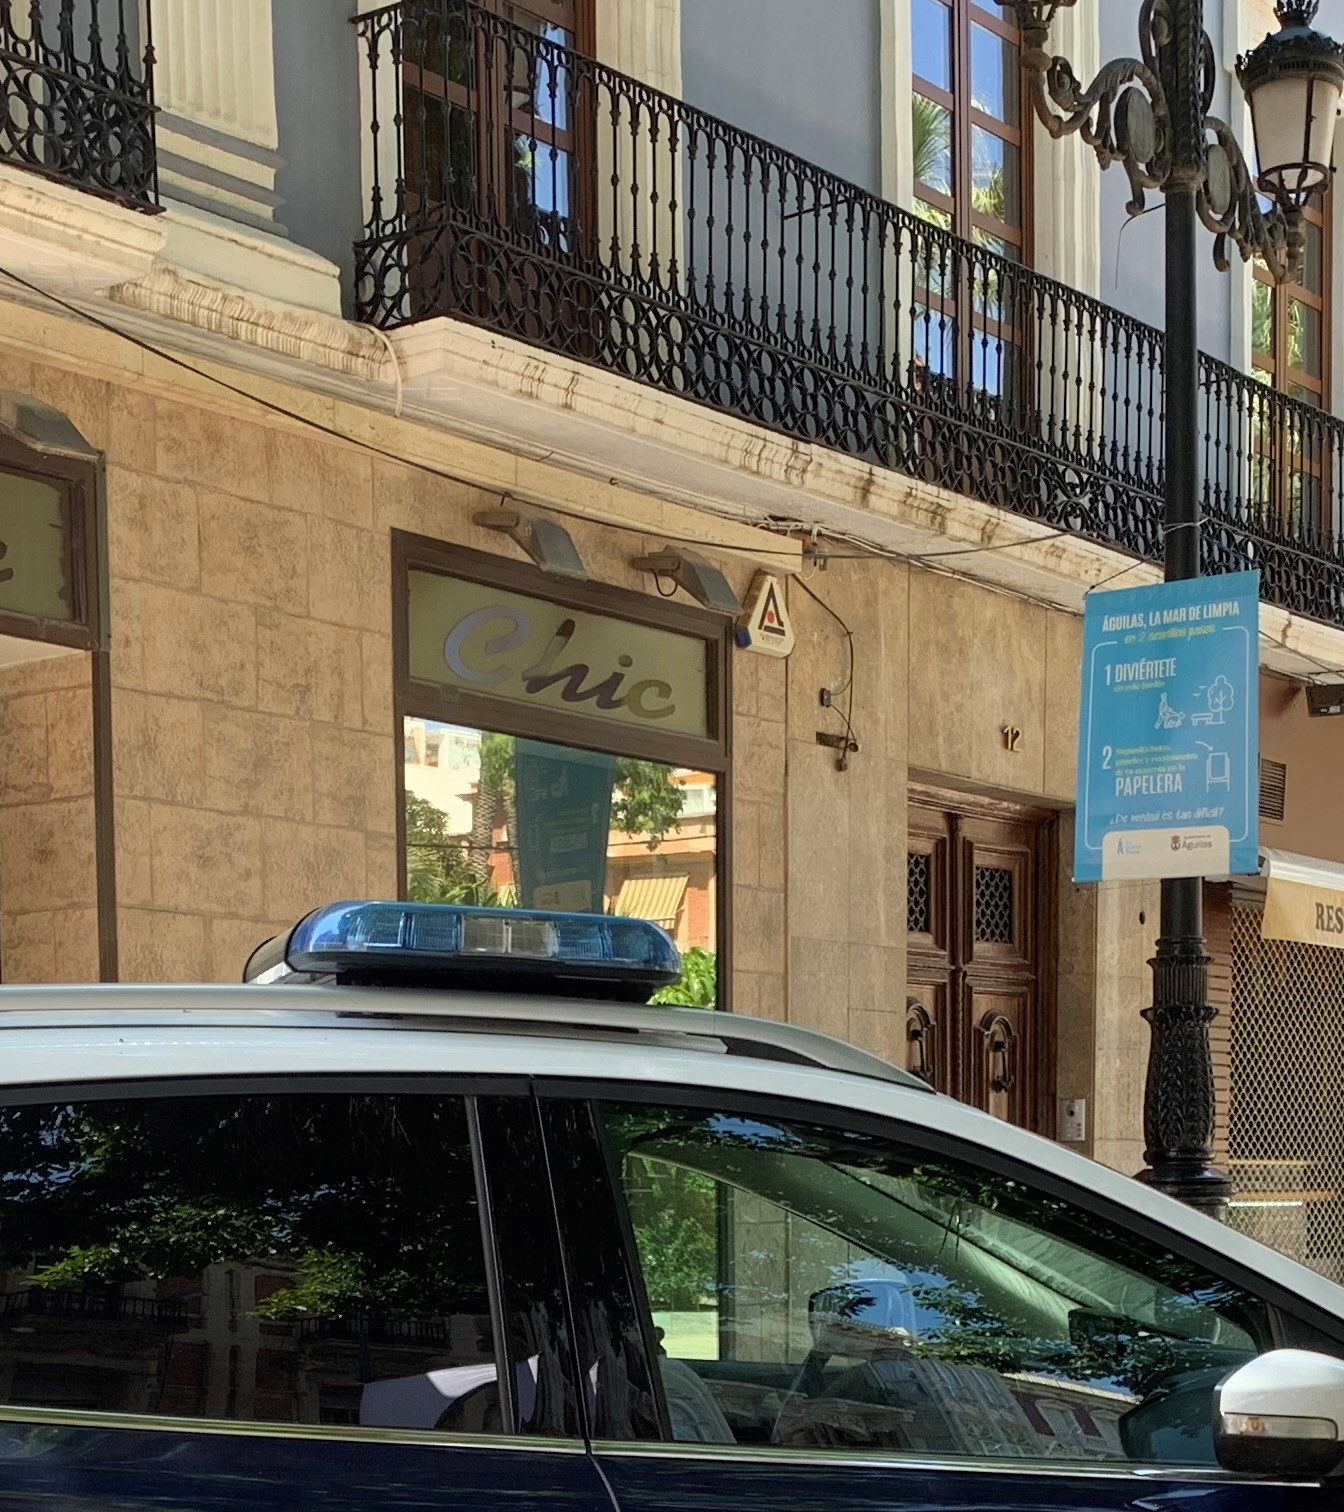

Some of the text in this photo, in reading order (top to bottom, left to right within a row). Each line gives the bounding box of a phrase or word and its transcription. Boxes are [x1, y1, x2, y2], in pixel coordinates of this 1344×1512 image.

[1102, 601, 1240, 633] ÁGUILAS, LA MAR DE LIMPIA
[442, 604, 676, 719] Chic
[1104, 657, 1177, 686] 1 DIVIÉRTETE
[1101, 745, 1112, 770] 2
[1115, 773, 1183, 797] PAPELERA
